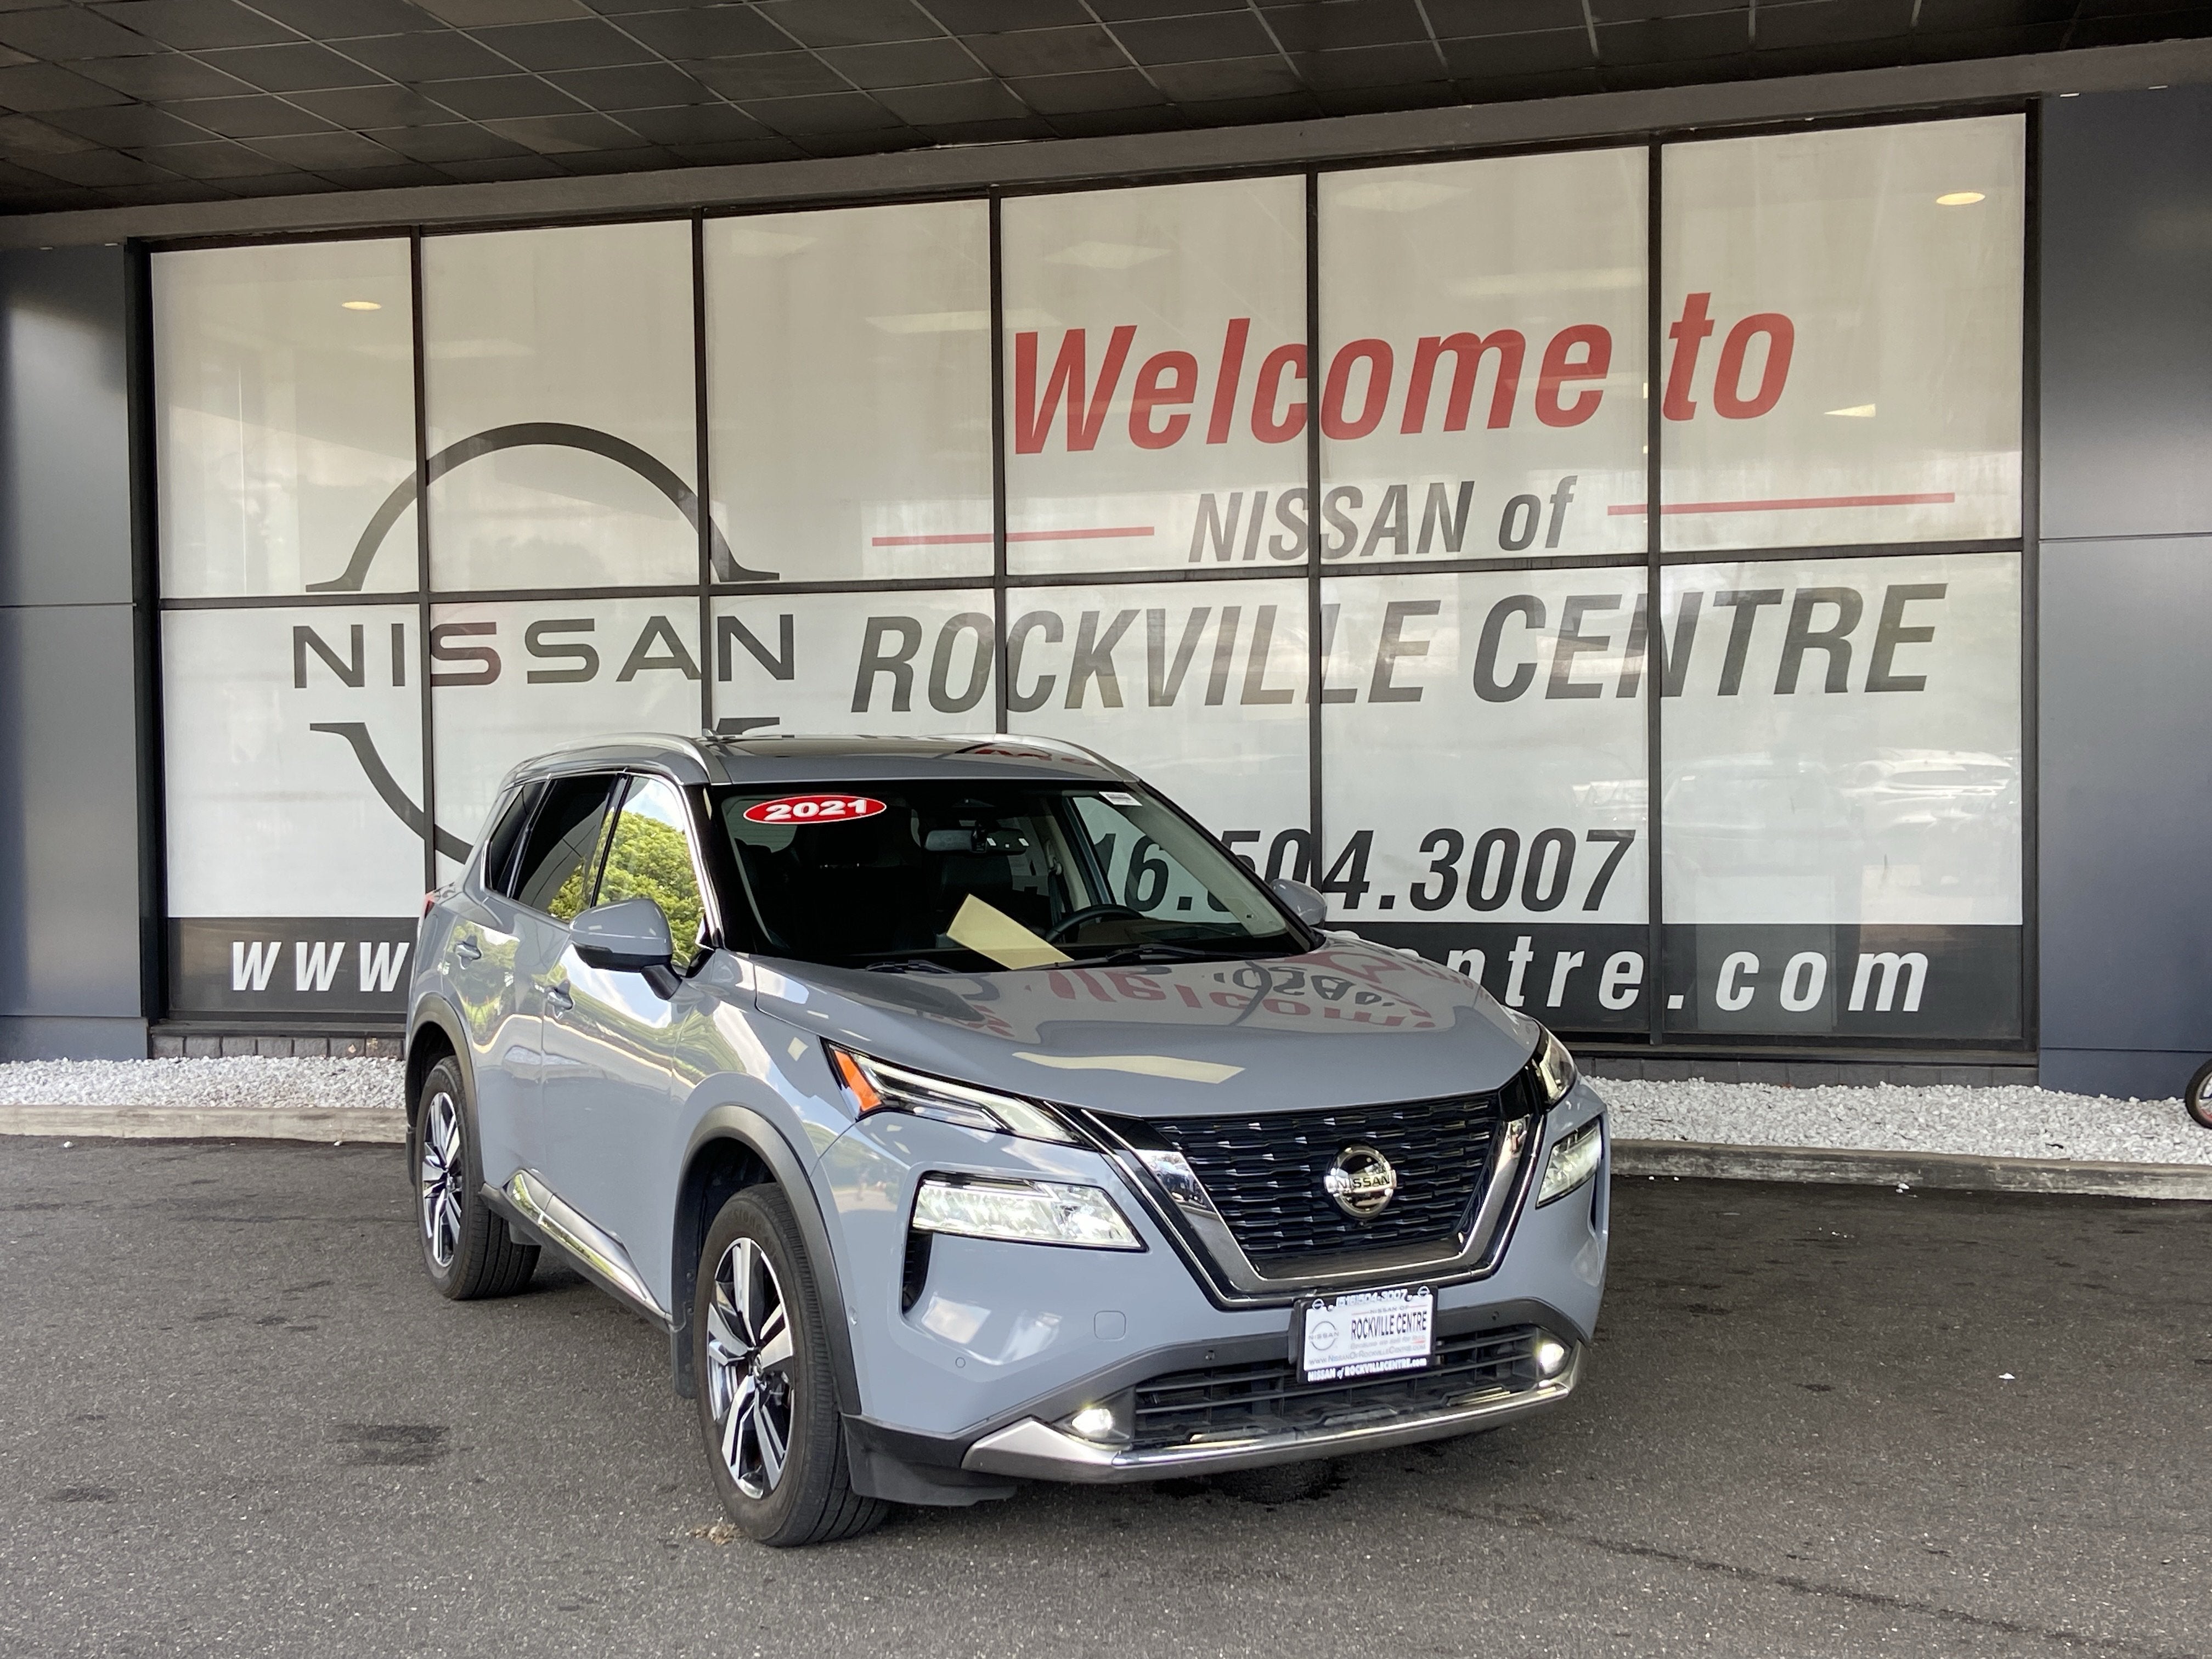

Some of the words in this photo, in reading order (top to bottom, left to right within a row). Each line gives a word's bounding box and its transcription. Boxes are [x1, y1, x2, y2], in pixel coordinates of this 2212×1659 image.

[1015, 318, 1612, 455] Welcome
[1662, 292, 1795, 421] to
[1188, 480, 1474, 563] NISSAN
[1499, 476, 1578, 550] of
[293, 614, 794, 689] NISSAN
[850, 599, 1441, 714] ROCKVILLE
[1472, 583, 1949, 702] CENTRE
[763, 799, 867, 821] 2021
[1336, 1175, 1390, 1189] NISSAN
[1308, 1331, 1339, 1340] NISSAN
[1351, 1314, 1395, 1340] ROCKVILLE
[1396, 1310, 1427, 1334] CENTRE
